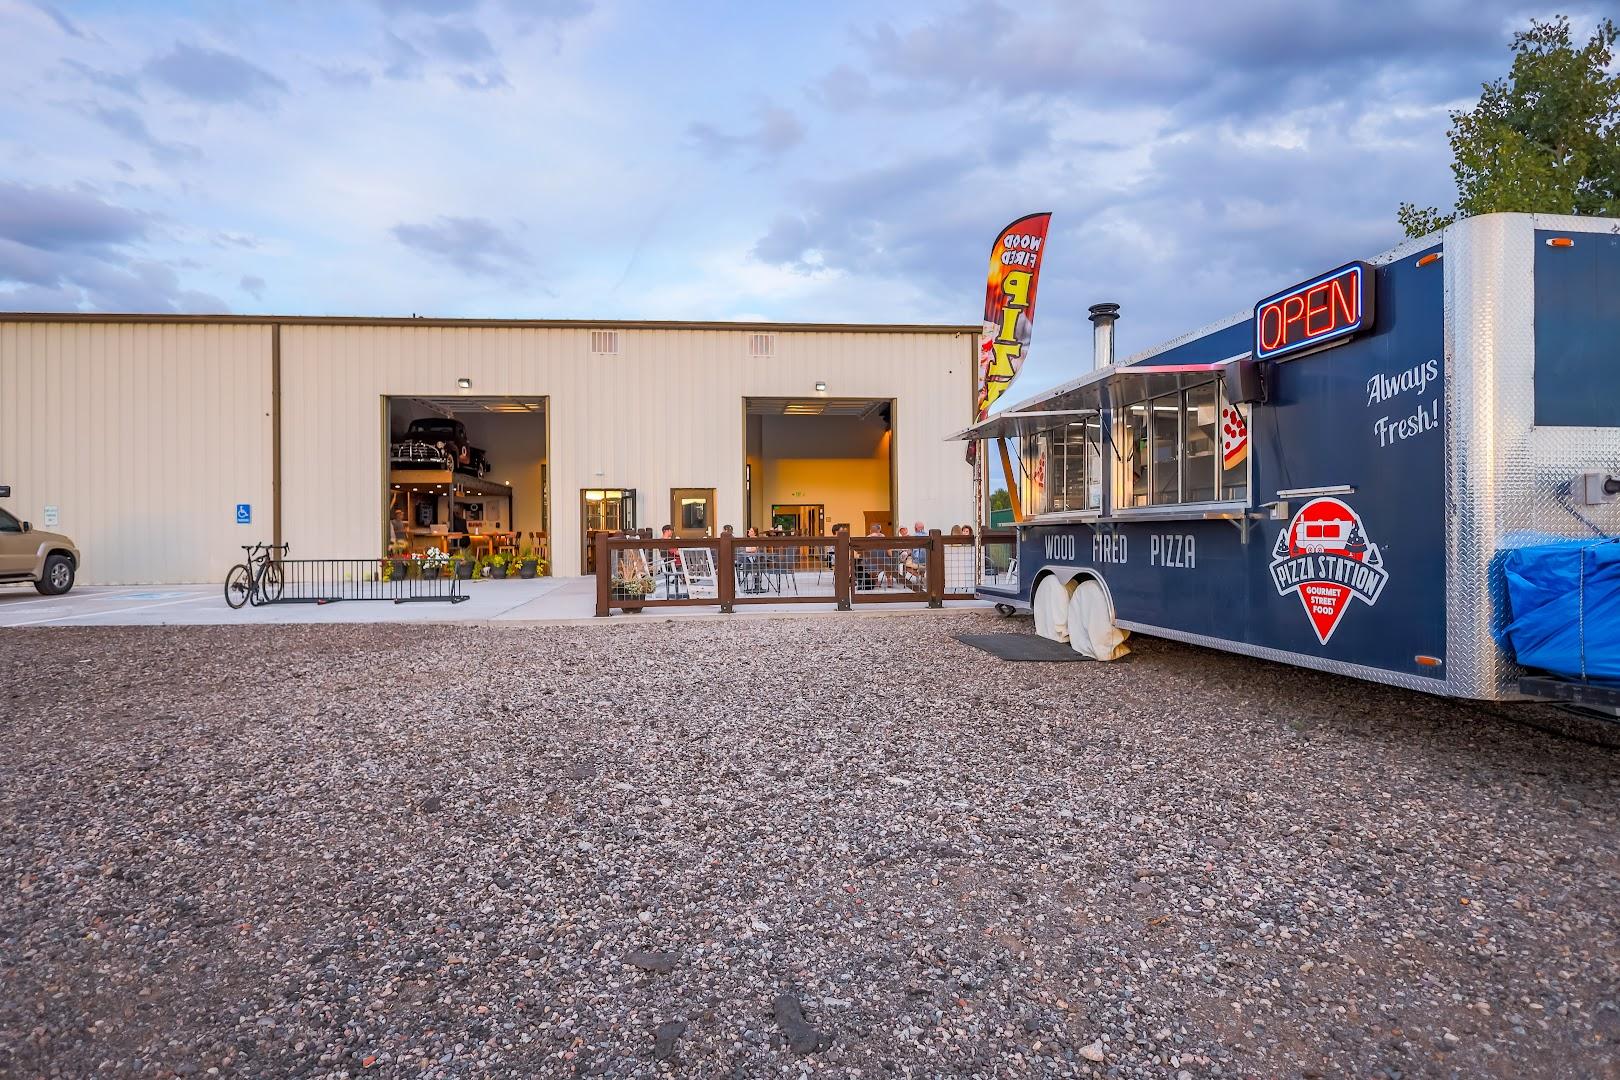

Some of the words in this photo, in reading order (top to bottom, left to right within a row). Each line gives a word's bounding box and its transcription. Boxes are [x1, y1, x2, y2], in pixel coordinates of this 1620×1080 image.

[1261, 272, 1357, 350] OPEN
[1366, 359, 1439, 407] Always
[1374, 399, 1439, 447] Fresh!
[1044, 534, 1075, 561] WOOD
[1092, 534, 1128, 564] FIRED
[1150, 534, 1196, 569] PIZZA
[1276, 556, 1315, 588] PIZZA
[1317, 555, 1380, 597] STATION
[1306, 586, 1341, 597] GOURMET
[1310, 597, 1337, 606] STREET
[1313, 606, 1333, 615] FOOD
